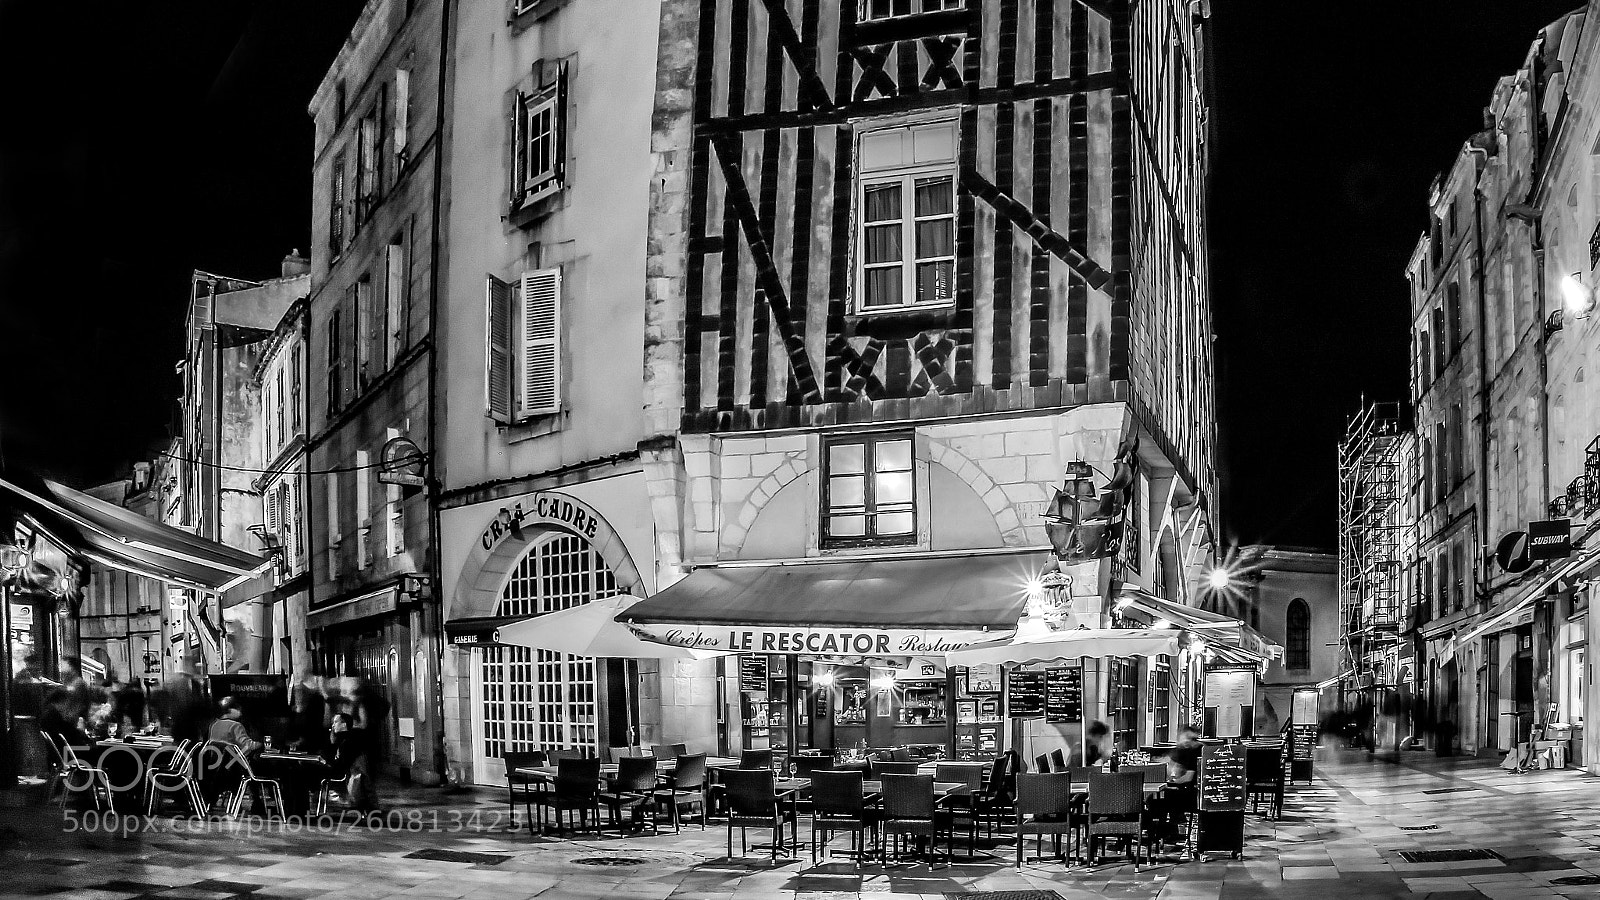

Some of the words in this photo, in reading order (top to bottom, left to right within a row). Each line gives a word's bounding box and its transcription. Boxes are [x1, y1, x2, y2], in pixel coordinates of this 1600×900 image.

[482, 503, 525, 550] CRA
[537, 498, 598, 538] CADRE
[1530, 534, 1569, 545] SUBWAY
[665, 628, 722, 649] Crêpes
[729, 631, 753, 650] LE
[761, 632, 891, 653] RESCATOR
